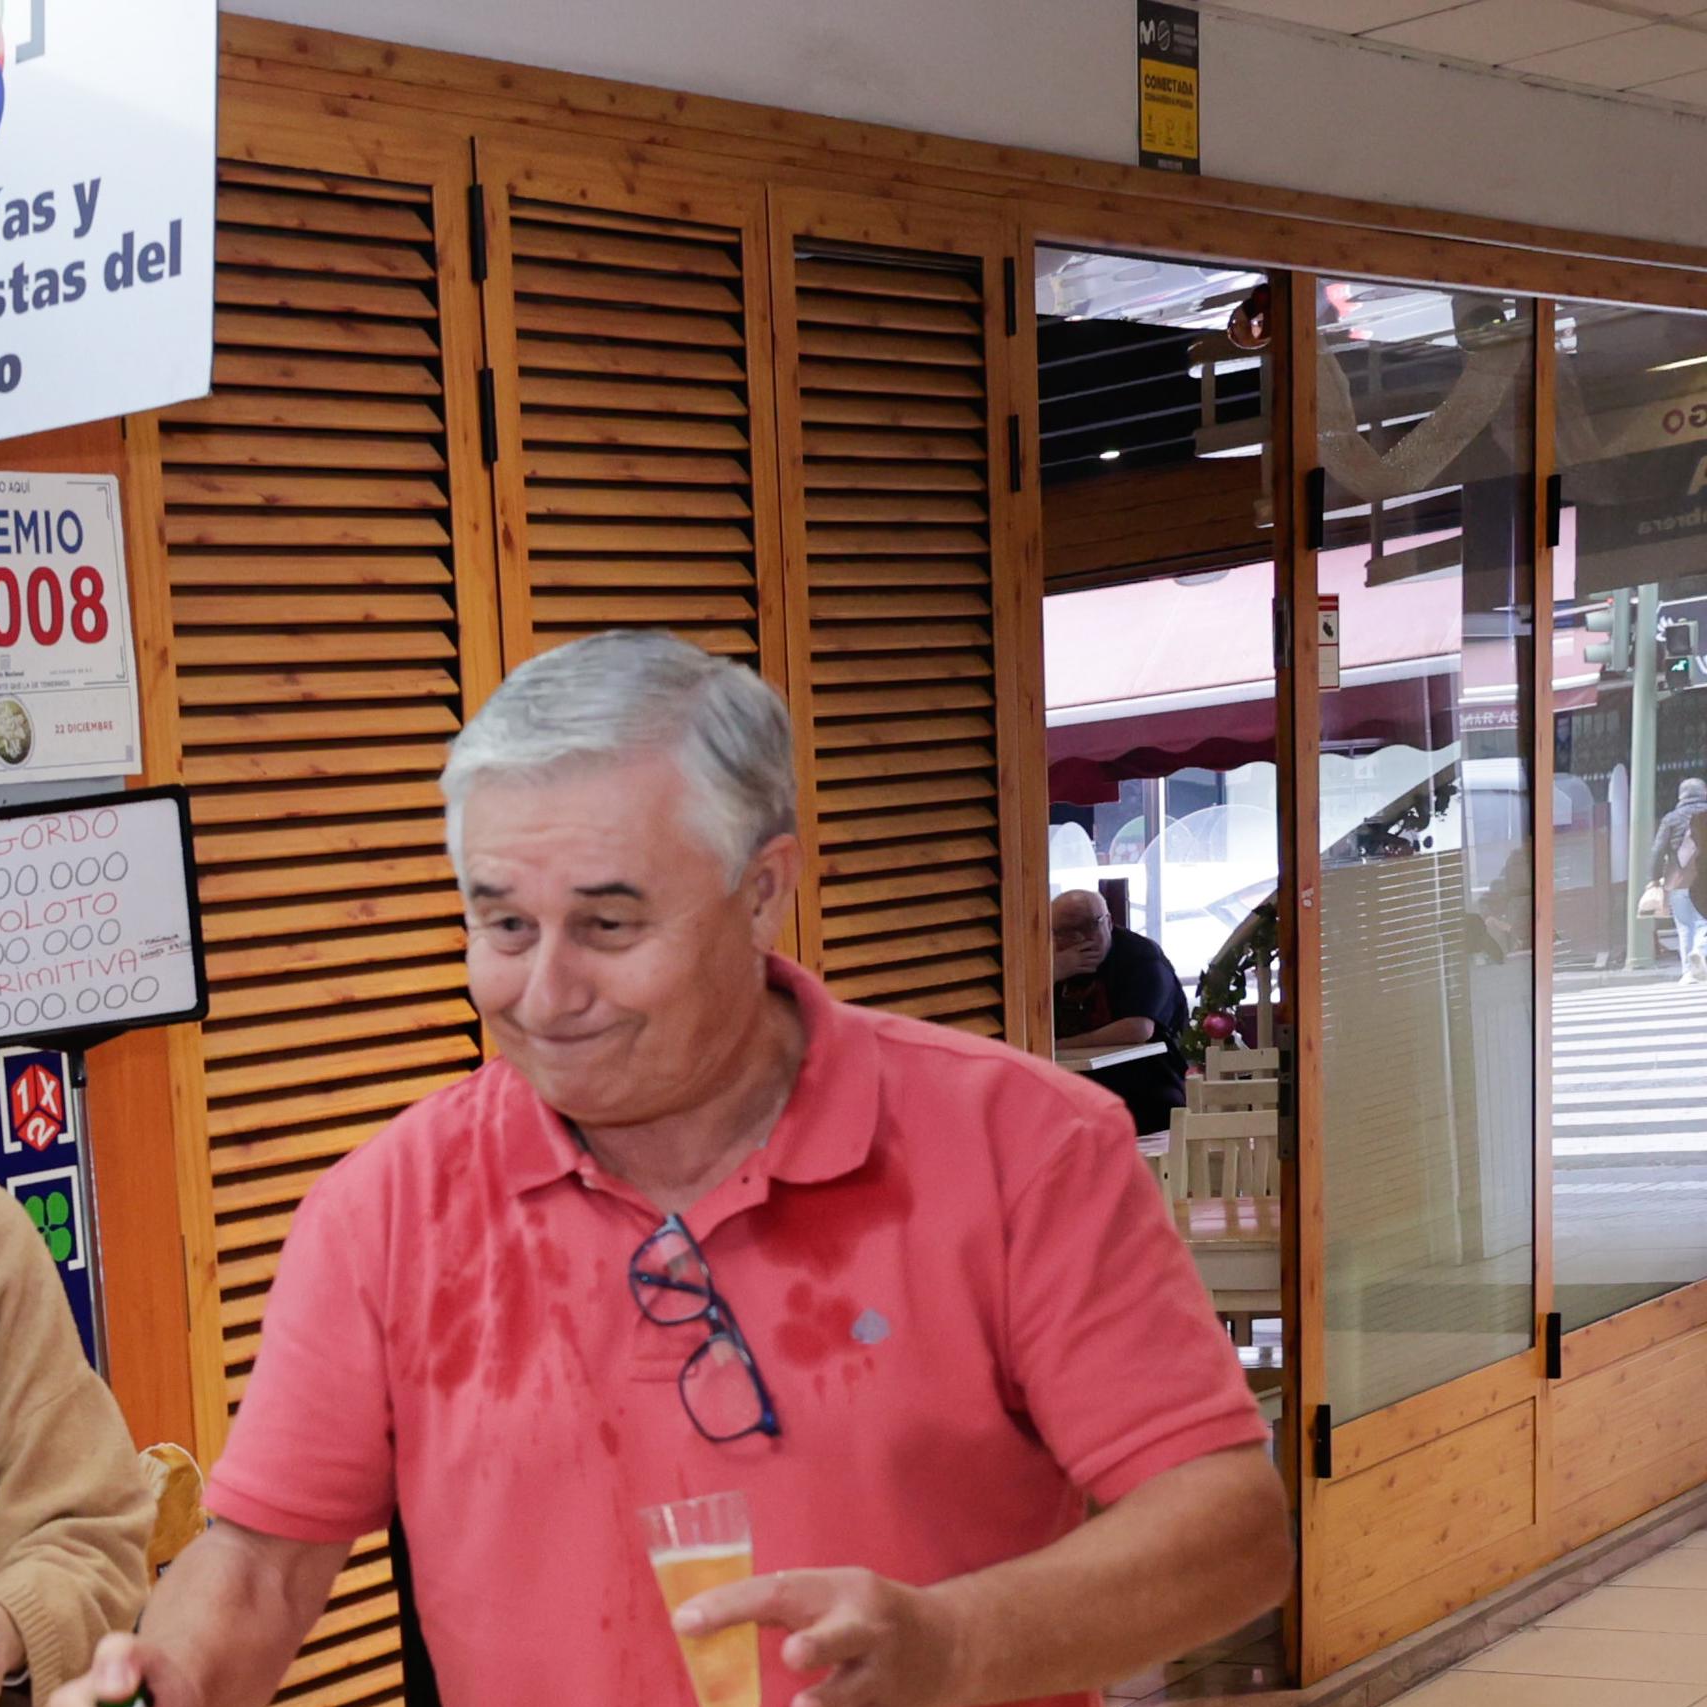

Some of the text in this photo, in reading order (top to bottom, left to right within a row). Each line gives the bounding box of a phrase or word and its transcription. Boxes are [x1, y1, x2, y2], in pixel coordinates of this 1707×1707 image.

[73, 177, 101, 238] y
[104, 219, 182, 292] del
[8, 481, 31, 494] AQUÍ
[55, 721, 114, 734] 22 DICIEMBRE
